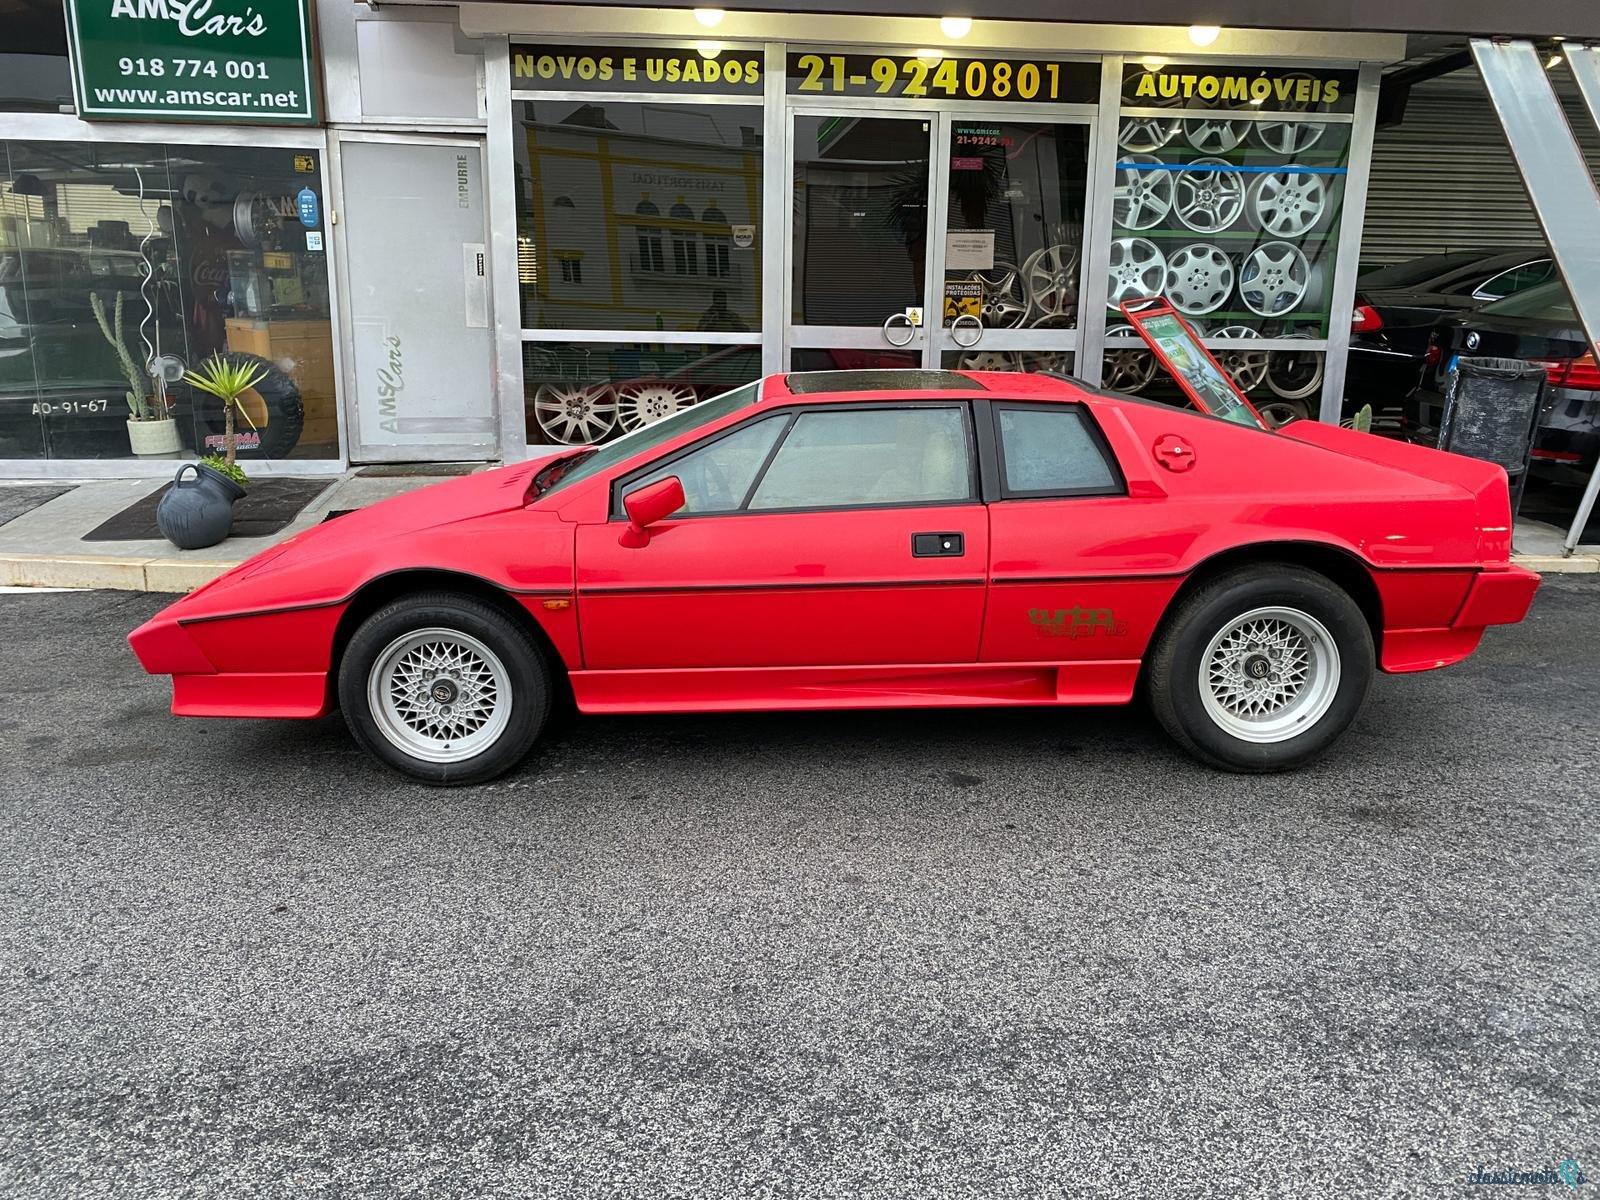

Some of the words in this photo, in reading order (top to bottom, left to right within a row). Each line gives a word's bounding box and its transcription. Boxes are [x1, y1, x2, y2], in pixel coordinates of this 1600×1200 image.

[111, 0, 186, 20] AMS
[178, 0, 267, 36] Car's
[119, 58, 165, 77] 918
[172, 59, 218, 78] 774
[225, 61, 269, 80] 001
[514, 54, 614, 81] NOVOS
[623, 58, 637, 81] E
[646, 58, 760, 84] USADOS
[798, 54, 1060, 99] 21-9240801
[94, 87, 299, 107] www.amscar.net
[1135, 71, 1340, 104] AUTOMÓVEIS
[456, 154, 469, 209] EMPURRE
[377, 386, 398, 434] AMS
